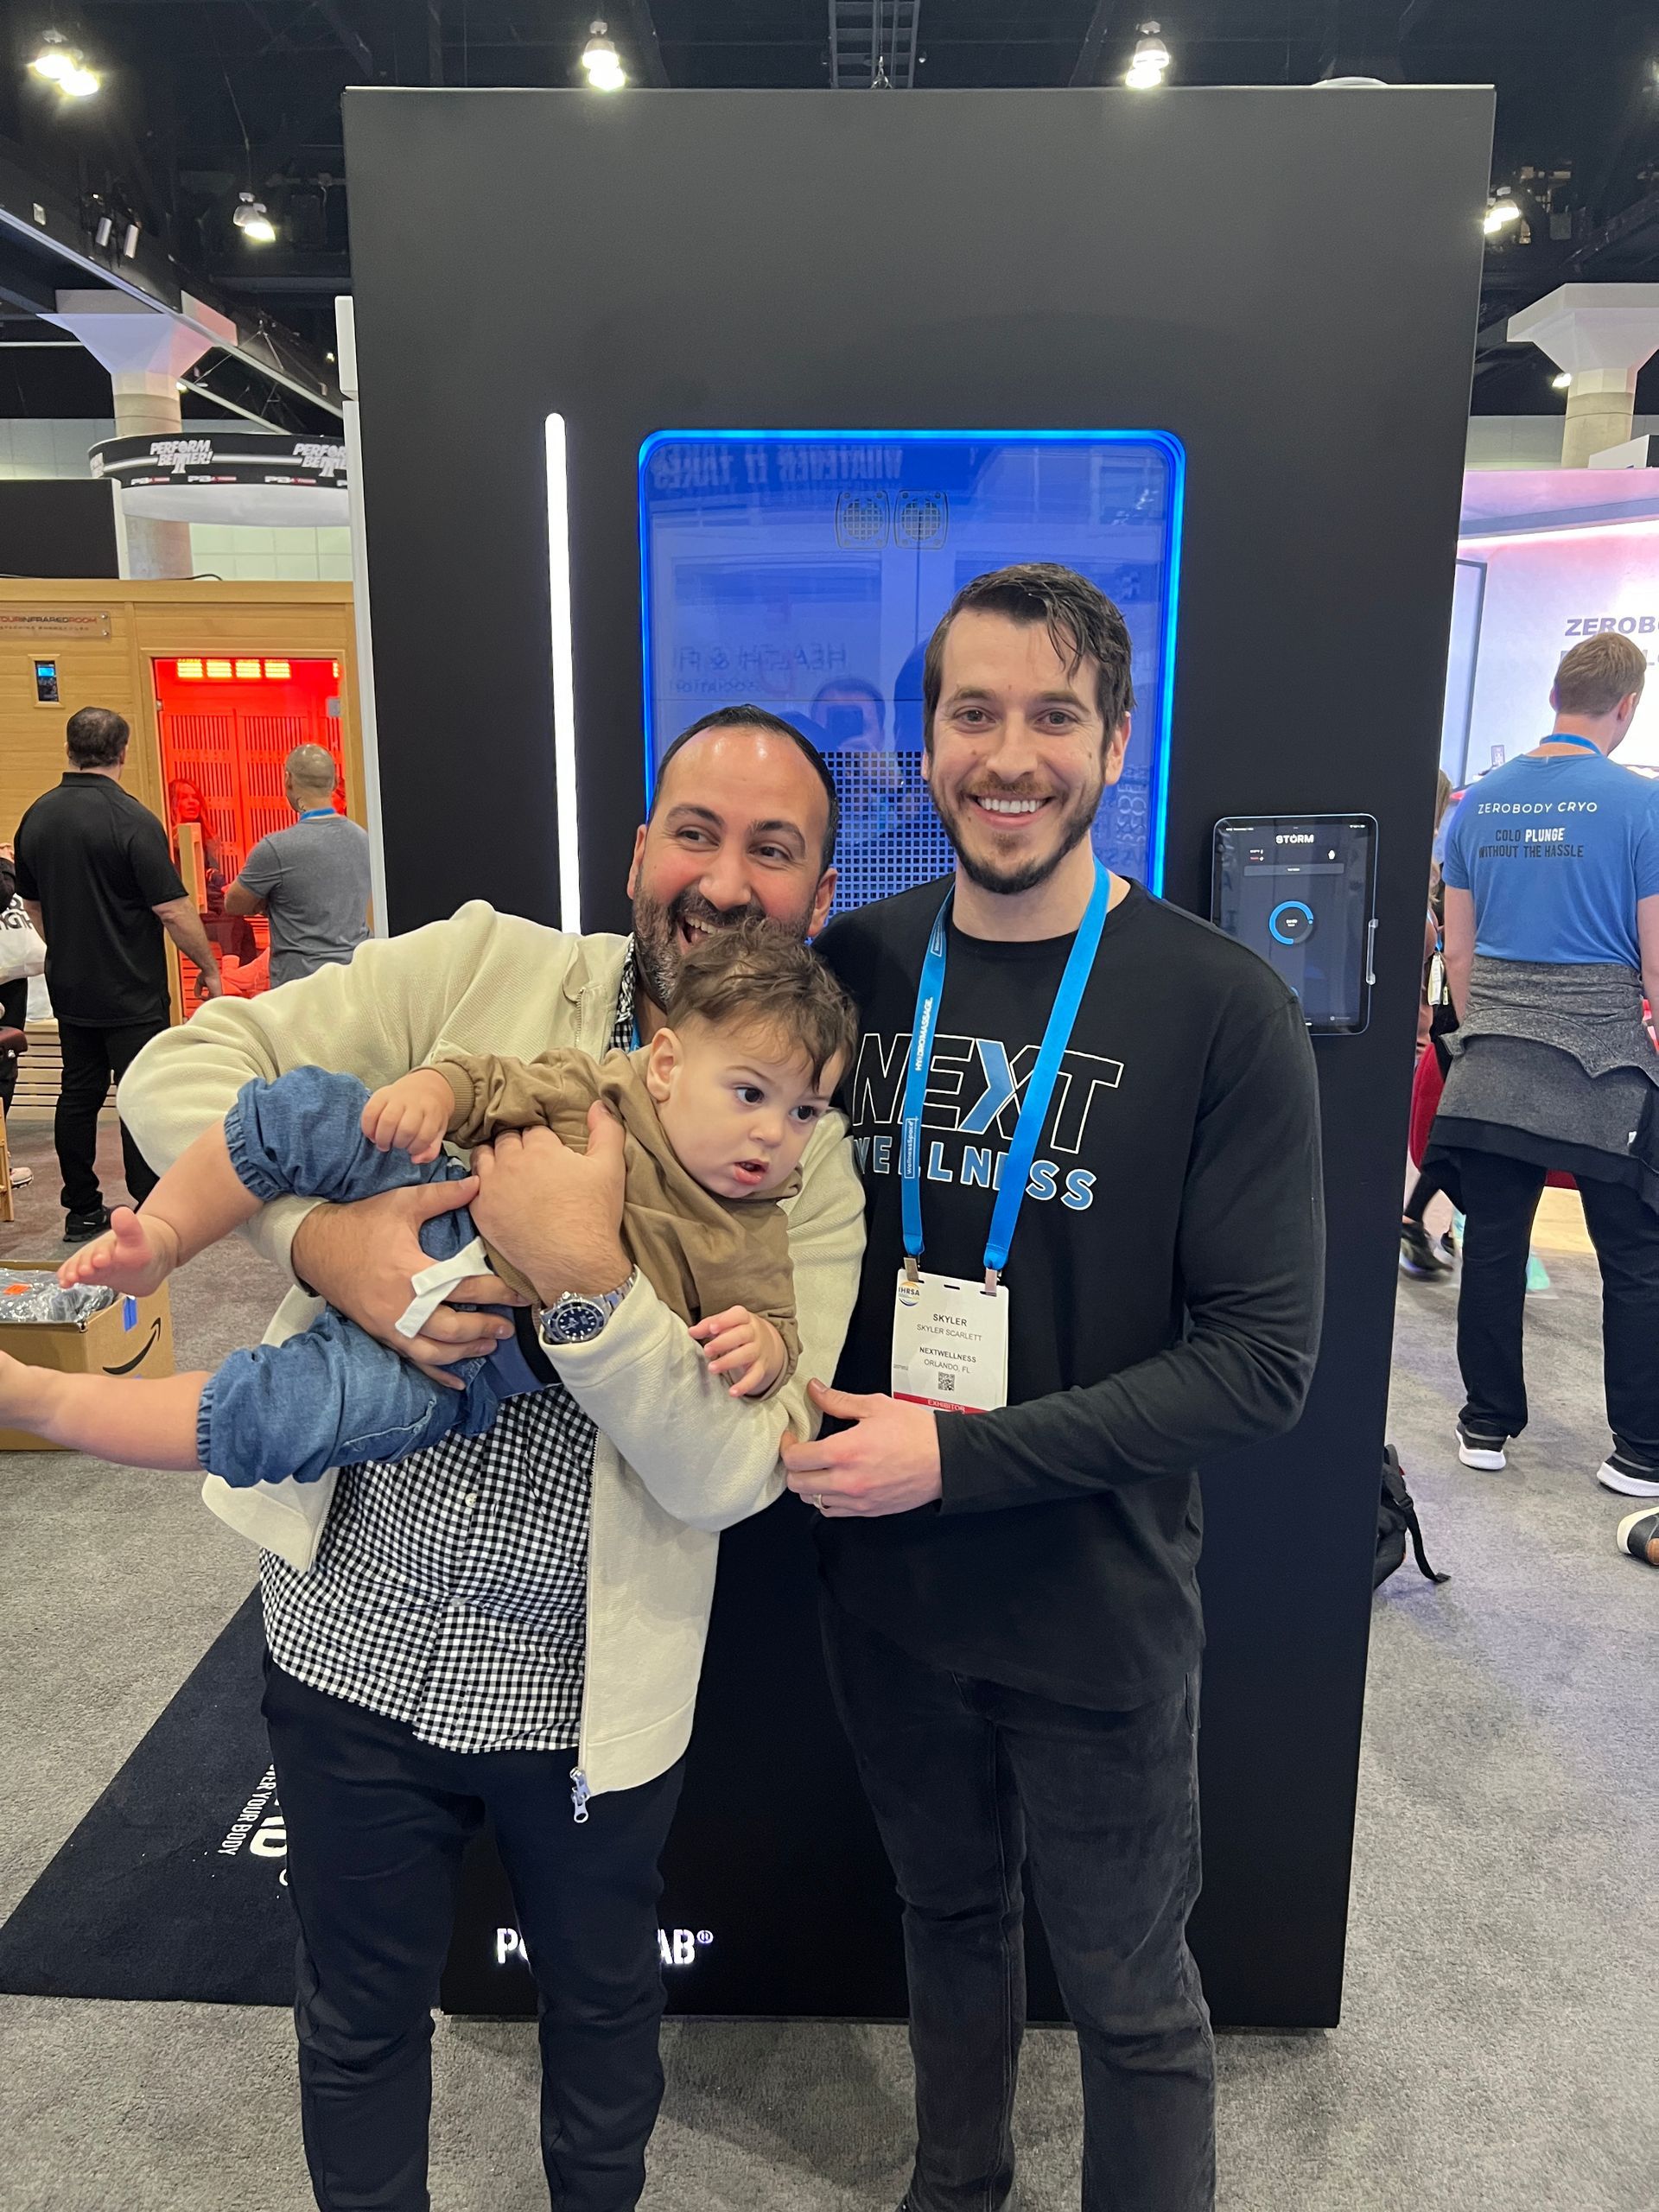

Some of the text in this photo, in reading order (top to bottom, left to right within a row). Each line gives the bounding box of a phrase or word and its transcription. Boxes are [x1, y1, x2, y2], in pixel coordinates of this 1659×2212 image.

[149, 440, 212, 455] PERFORM
[1565, 616, 1659, 637] ZEROB
[1478, 801, 1598, 815] ZEROBODY CRYO
[1275, 834, 1314, 844] STORM
[1496, 828, 1565, 842] COLD PLUNGE
[1478, 844, 1584, 859] WITHOUT THE HASSLE
[853, 1033, 1124, 1154] NEXT
[853, 1135, 1096, 1210] WELNSS
[899, 1287, 920, 1296] IHRSA
[932, 1313, 967, 1327] SKYLER
[917, 1324, 982, 1341] SKYLER SCARLETT
[919, 1346, 976, 1363] NEXTWELLNESS
[924, 1358, 959, 1372] ORLANDO,
[237, 1791, 272, 1821] YOUR
[218, 1824, 253, 1856] BODY
